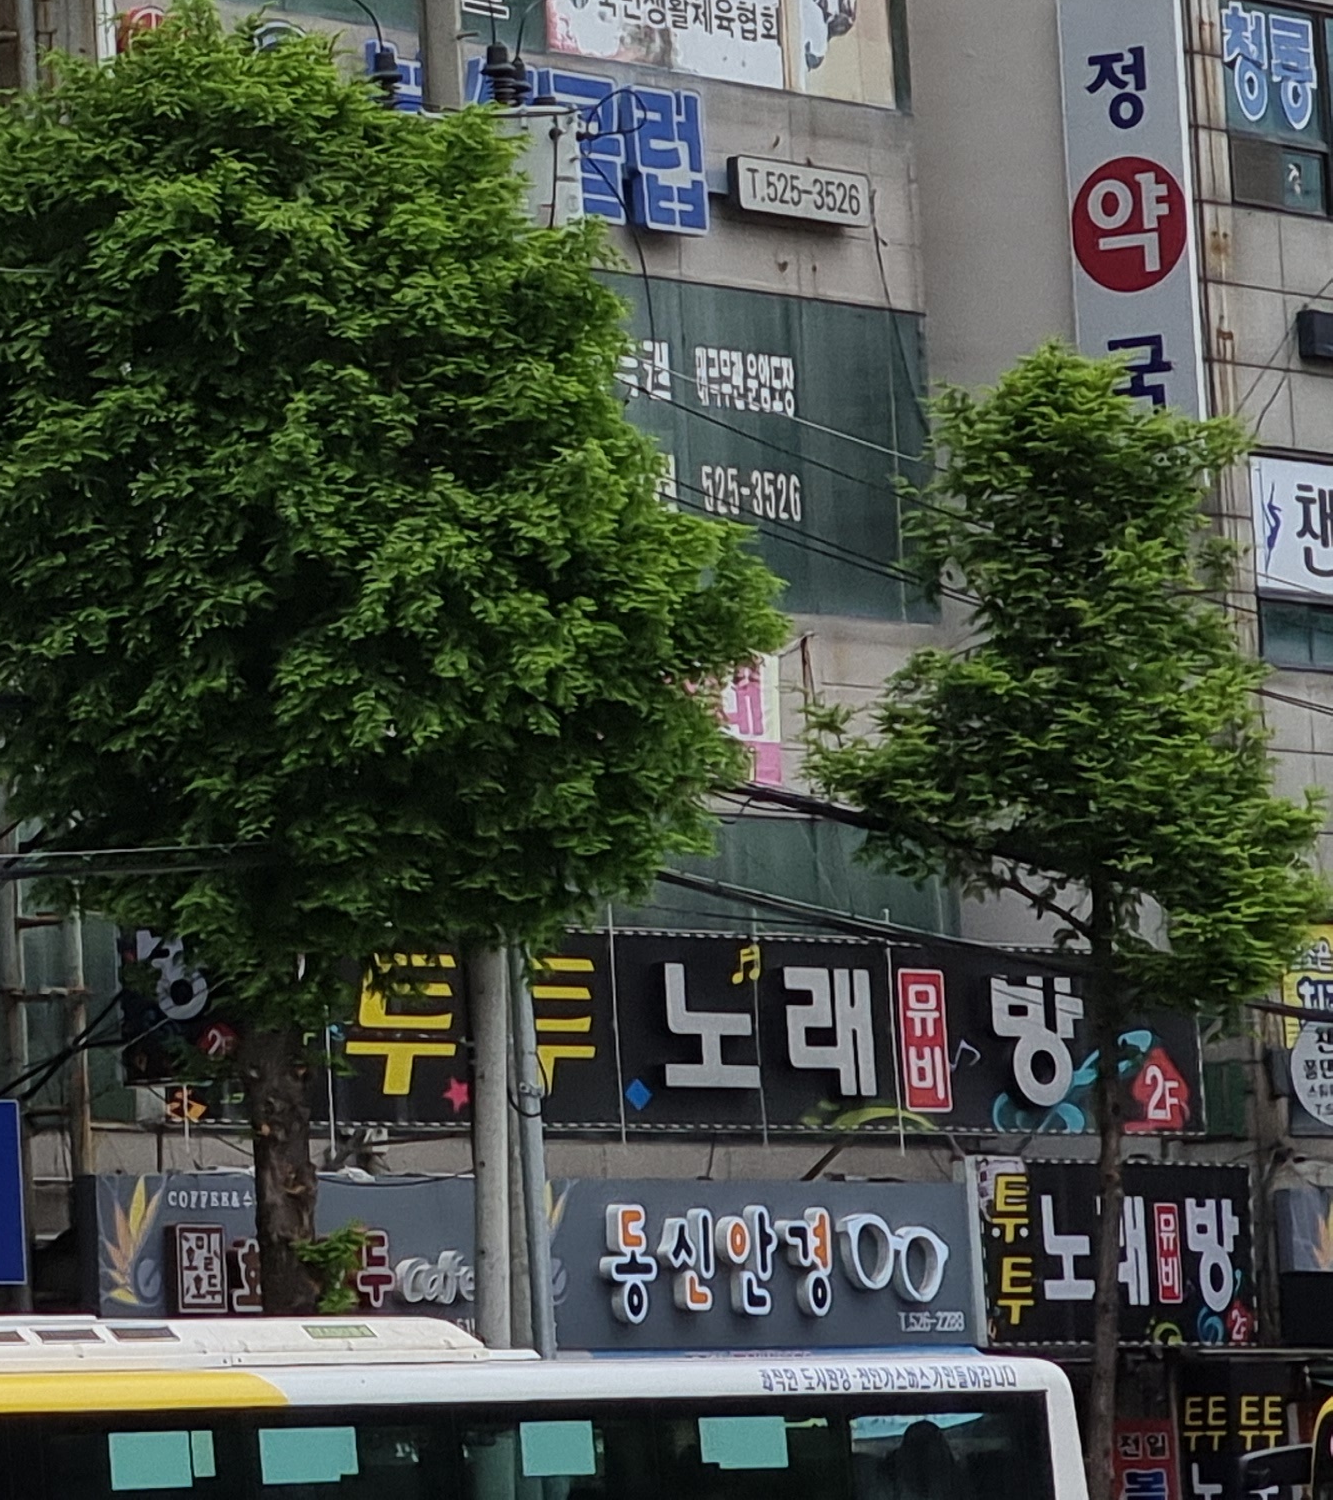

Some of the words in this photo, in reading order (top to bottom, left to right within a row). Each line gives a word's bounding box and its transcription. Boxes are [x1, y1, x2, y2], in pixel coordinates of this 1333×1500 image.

[744, 165, 862, 218] T.525-3526
[701, 465, 802, 522] 525-3526
[600, 1203, 832, 1326] 동신안경
